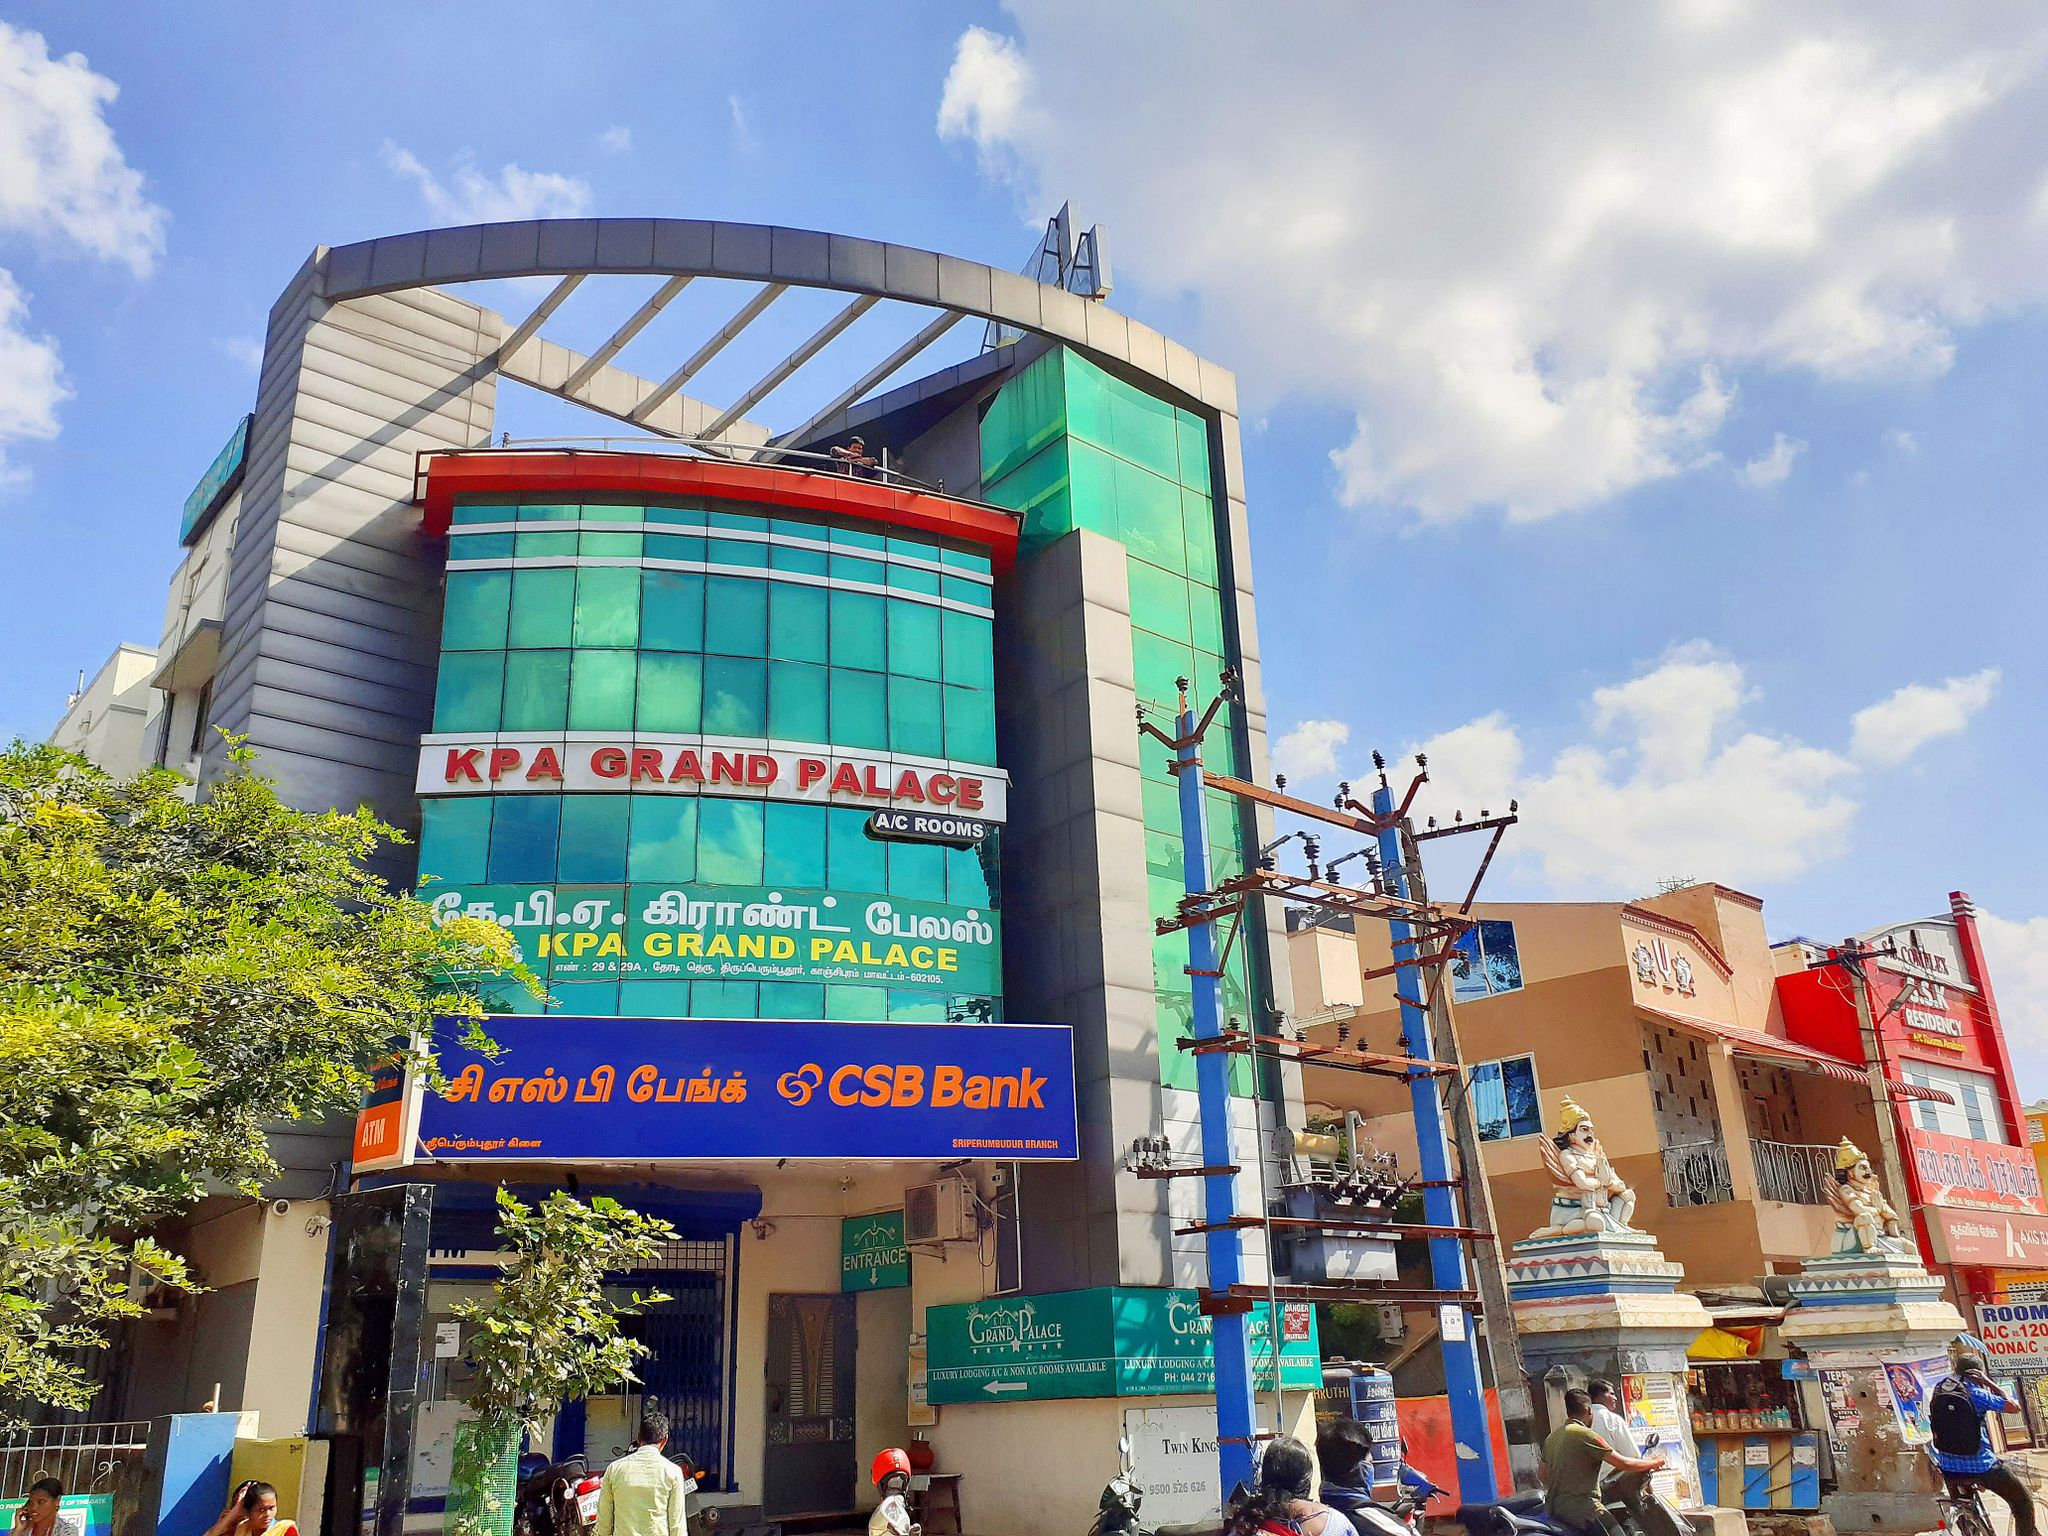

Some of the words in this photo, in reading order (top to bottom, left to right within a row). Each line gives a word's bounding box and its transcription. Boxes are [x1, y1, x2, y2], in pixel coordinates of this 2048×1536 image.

[445, 747, 565, 782] KPA
[590, 747, 778, 787] GRAND
[797, 758, 984, 810] PALACE
[876, 813, 908, 831] A/C
[915, 817, 984, 838] ROOMS
[642, 890, 850, 932] கிராண்ட்
[865, 901, 993, 945] பேலஸ்
[537, 932, 628, 958] KPA
[643, 933, 796, 959] GRAND
[810, 938, 958, 972] PALACE
[592, 962, 605, 972] 29
[608, 962, 617, 972] &
[1905, 1008, 1962, 1037] RESIDENCY
[445, 1064, 485, 1102] சி
[488, 1067, 569, 1103] எஸ்
[574, 1065, 616, 1103] பி
[626, 1064, 748, 1103] பேங்க்
[828, 1064, 925, 1107] CSB
[930, 1065, 1049, 1110] Bank
[361, 1117, 386, 1148] ATM
[507, 1137, 542, 1148] கிளை
[952, 1138, 1024, 1149] SRIPERUMBUDUR
[1025, 1139, 1058, 1149] BRANCH
[2020, 1229, 2039, 1245] AXIS
[843, 1248, 907, 1271] ENTRANCE
[1284, 1304, 1309, 1312] DANGER
[968, 1313, 1015, 1344] GRAND
[1018, 1309, 1062, 1340] PALACE
[1169, 1302, 1213, 1335] GRAN
[1984, 1325, 2009, 1340] A/C
[933, 1369, 958, 1380] LUXURY
[959, 1367, 990, 1379] LODGING
[1003, 1366, 1009, 1377] &
[1010, 1365, 1026, 1376] NON
[1039, 1363, 1065, 1374] ROOMS
[1065, 1361, 1107, 1373] AVAILABLE
[1124, 1359, 1157, 1369] LUXURY
[1158, 1359, 1195, 1369] LODGING
[1164, 1372, 1179, 1382] PH:
[1180, 1372, 1195, 1382] 044
[1313, 1384, 1350, 1400] HRUTHI
[1162, 1439, 1188, 1454] TWIN
[1149, 1483, 1170, 1495] 9500
[1172, 1482, 1189, 1494] 526
[1190, 1481, 1206, 1492] 626
